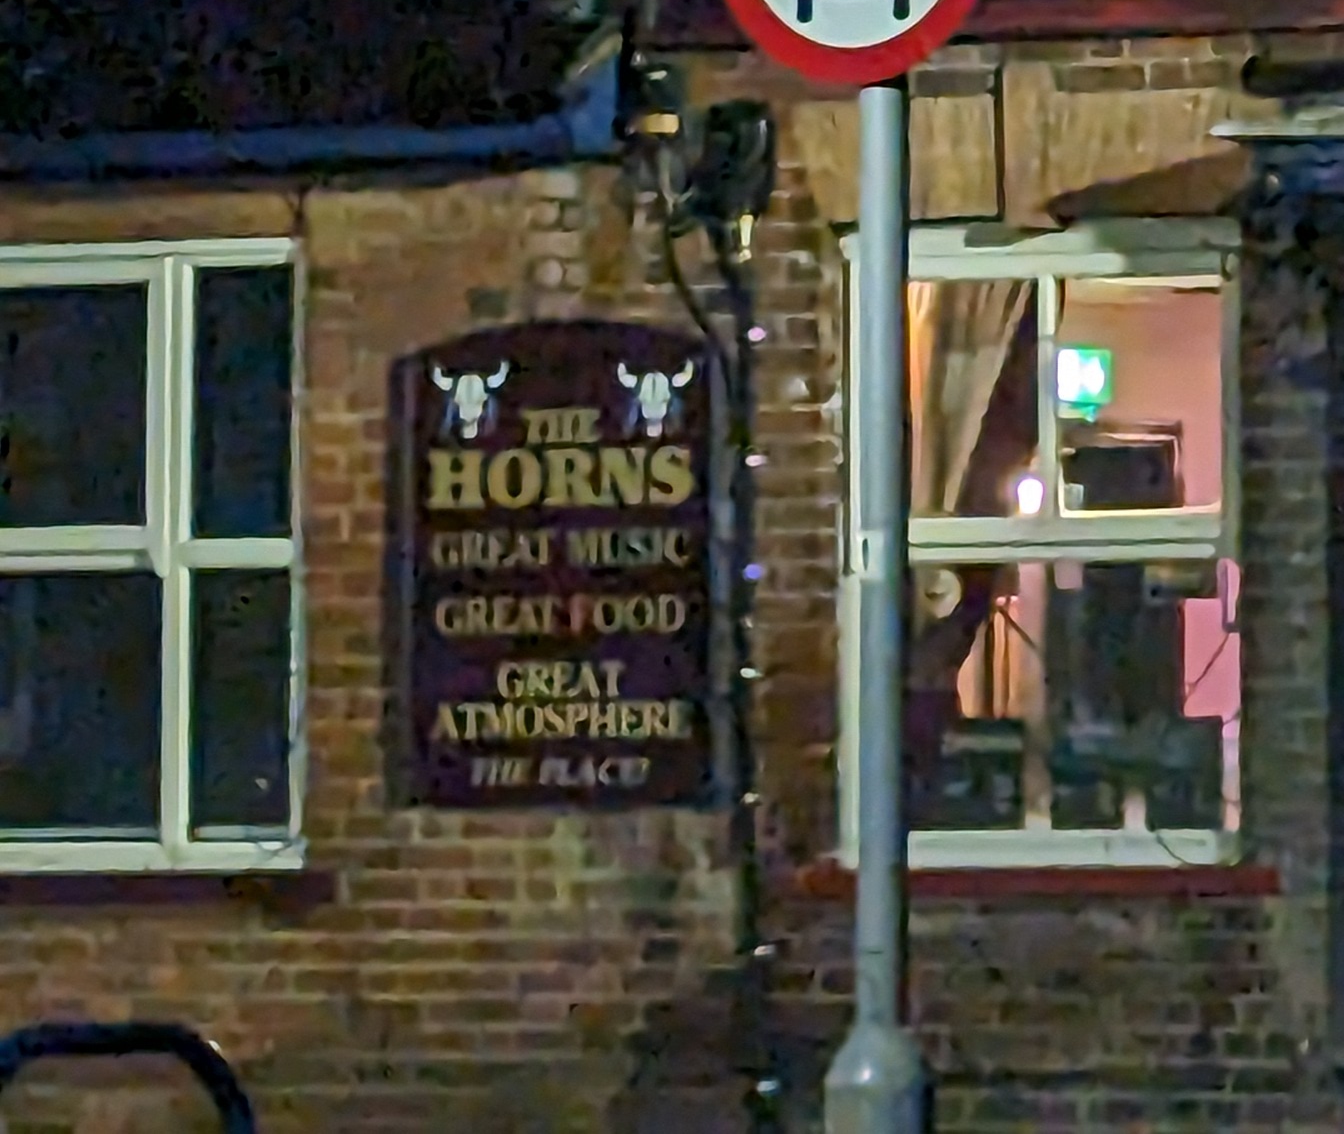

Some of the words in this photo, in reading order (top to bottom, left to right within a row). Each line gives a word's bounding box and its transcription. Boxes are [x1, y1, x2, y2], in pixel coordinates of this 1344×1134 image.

[427, 446, 694, 510] HORNS
[432, 531, 553, 567] GREAT
[566, 530, 692, 566] MUSIC
[435, 596, 559, 635] GREAT
[566, 593, 687, 634] FOOD
[496, 661, 624, 698] GREAT
[433, 702, 690, 740] ATMOSPHERE
